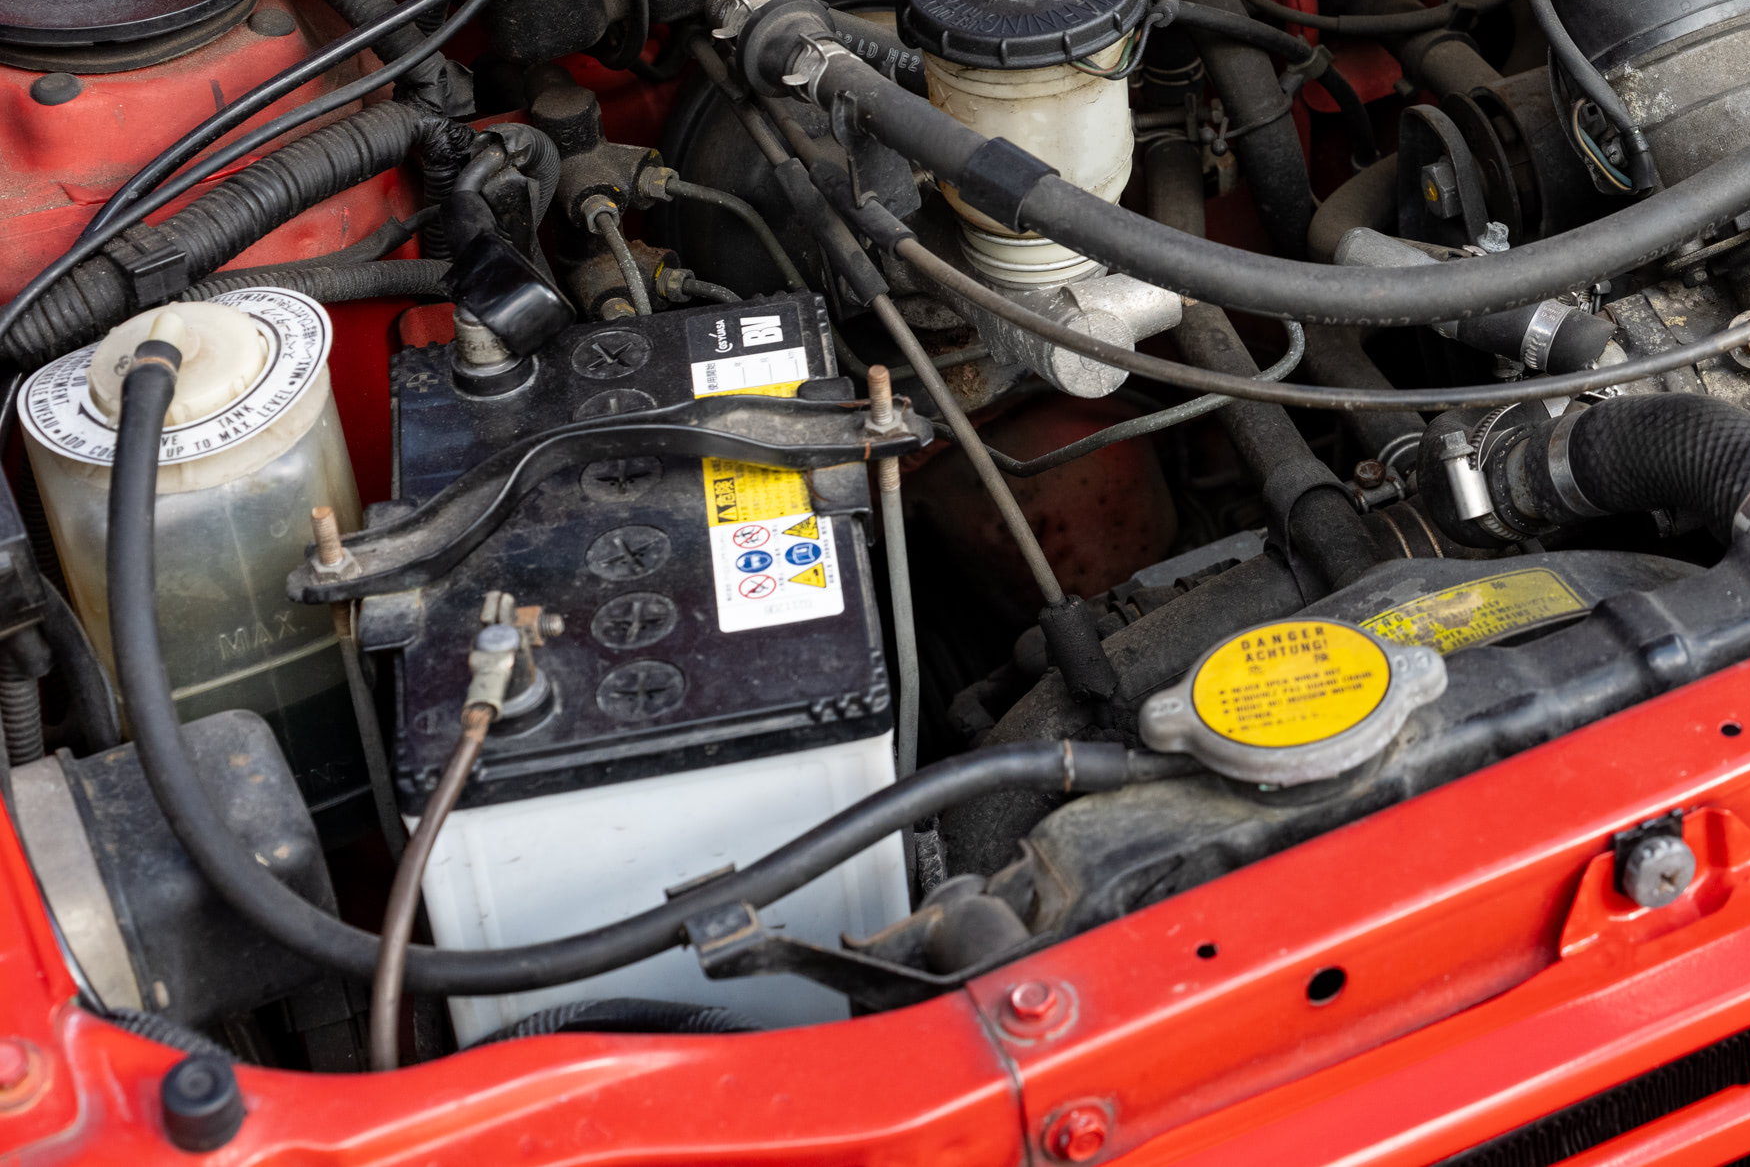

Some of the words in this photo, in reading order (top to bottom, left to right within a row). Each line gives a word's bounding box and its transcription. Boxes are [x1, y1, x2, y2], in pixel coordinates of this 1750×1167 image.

[166, 445, 185, 459] UP
[195, 439, 212, 452] TO
[218, 421, 251, 443] MAX.
[261, 389, 294, 420] LEVEL
[217, 405, 255, 429] TANK
[59, 432, 86, 450] ADD
[1241, 626, 1325, 651] DANGER
[1245, 639, 1329, 663] ACHTUNG!
